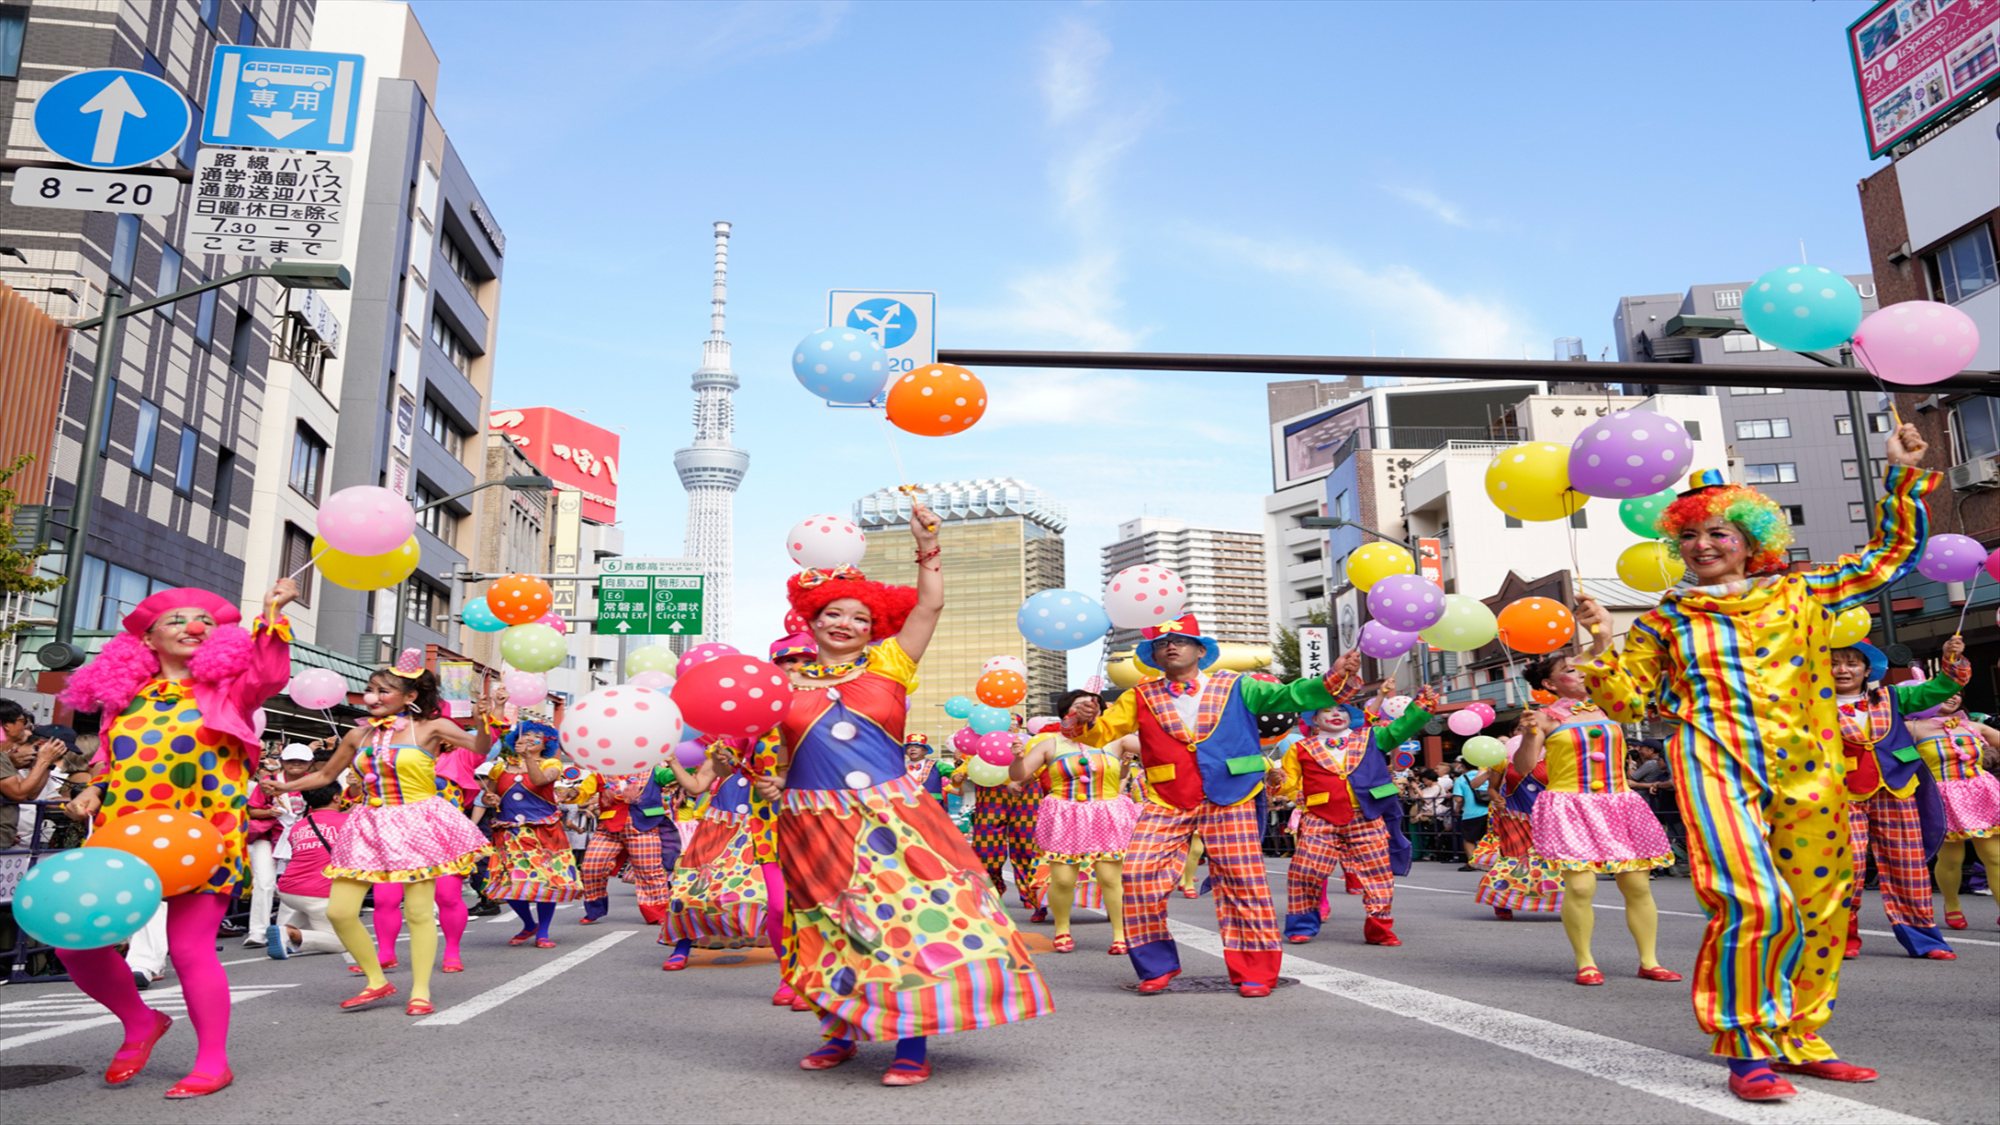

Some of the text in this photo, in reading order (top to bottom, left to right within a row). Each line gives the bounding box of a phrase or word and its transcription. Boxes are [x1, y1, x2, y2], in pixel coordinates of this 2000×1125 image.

[249, 88, 320, 112] 専用
[214, 153, 333, 173] 路線バス
[198, 182, 341, 204] 通勤送迎バス
[204, 236, 322, 256] ここまで
[608, 562, 616, 570] 6
[624, 562, 658, 571] 首都高
[605, 578, 645, 588] 向島入口
[658, 578, 697, 588] 駒形入口
[604, 602, 645, 612] 常磐道
[655, 602, 699, 612] 都心環状
[599, 612, 628, 620] JOBAN
[656, 612, 697, 620] Circle 1
